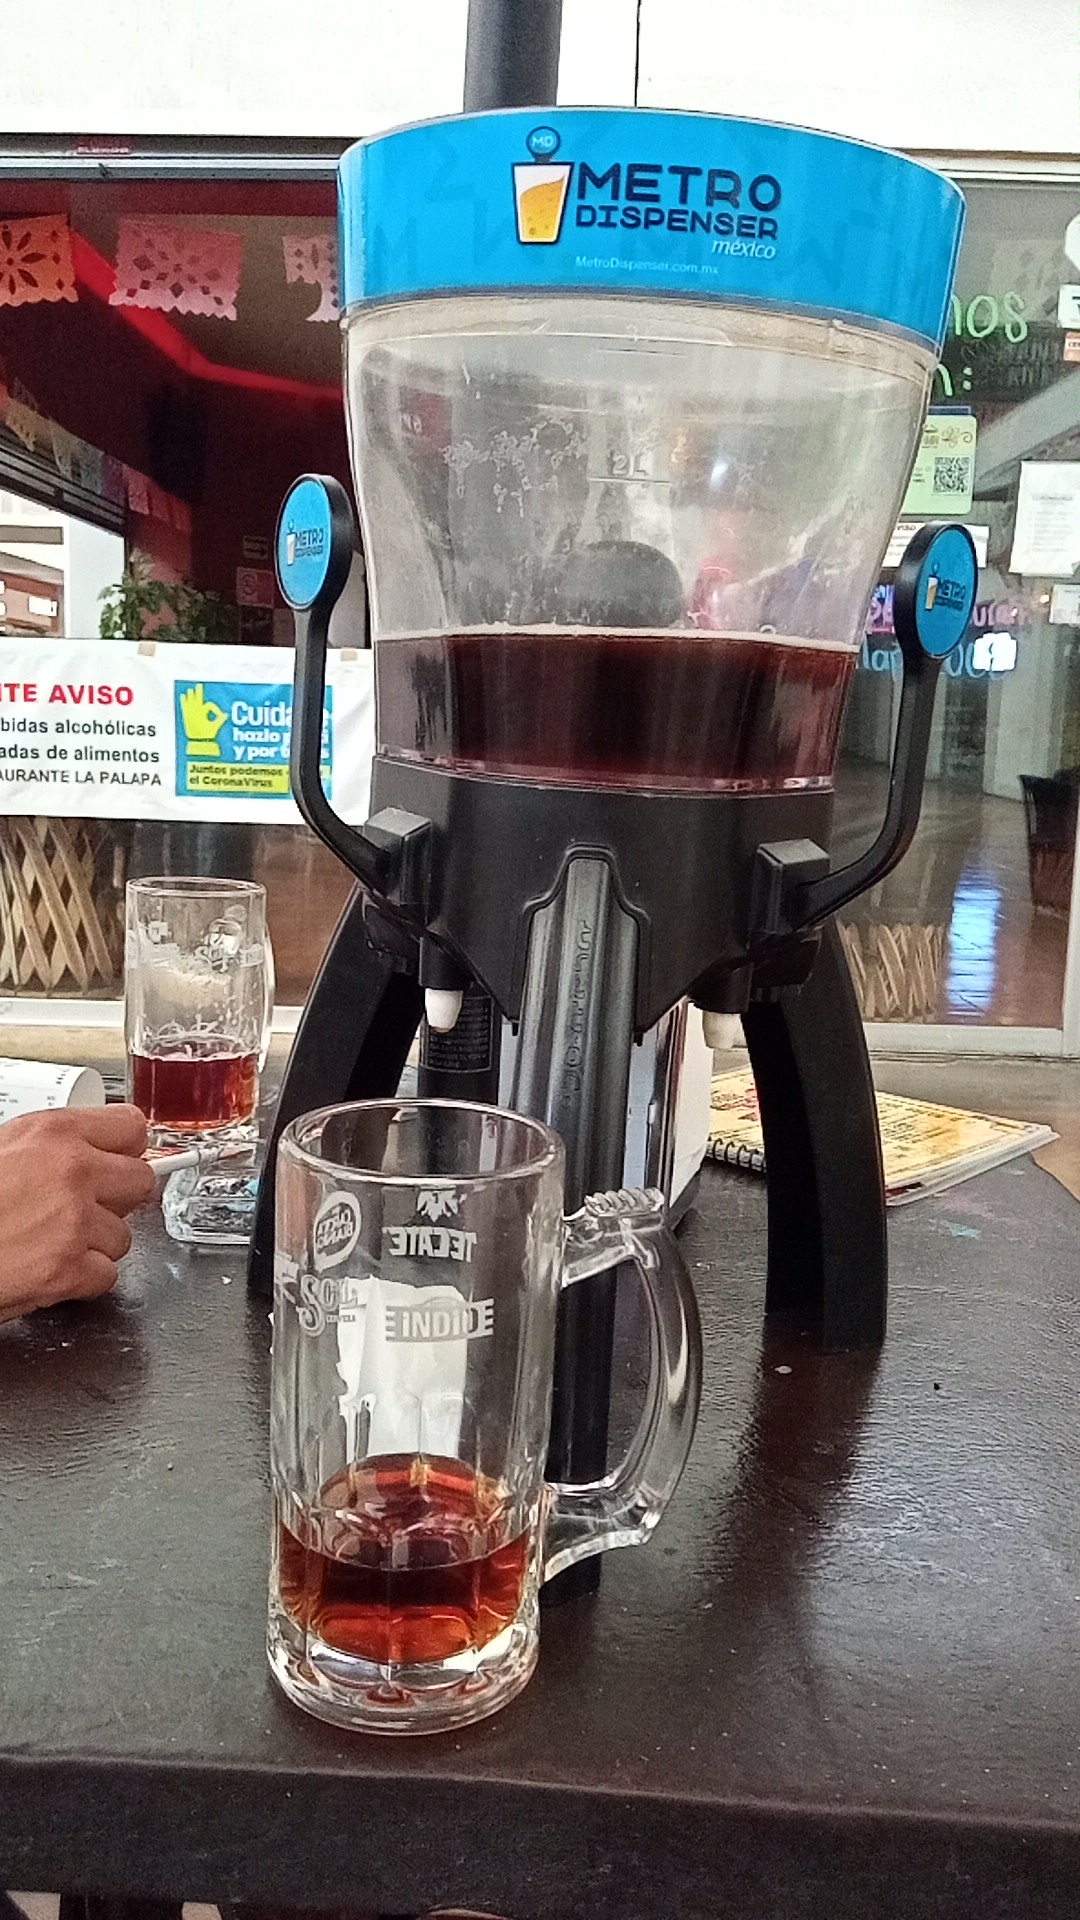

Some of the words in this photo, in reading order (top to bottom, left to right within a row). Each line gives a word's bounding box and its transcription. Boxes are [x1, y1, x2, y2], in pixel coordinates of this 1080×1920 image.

[577, 161, 782, 213] METRO
[575, 204, 778, 241] DISPENSER
[711, 239, 777, 260] méxico
[0, 683, 37, 703] TE
[48, 685, 134, 706] AVISO
[1, 717, 49, 734] bidas
[55, 719, 157, 738] alcohólicas
[47, 745, 68, 760] de
[74, 746, 160, 764] alimentos
[233, 746, 246, 761] y
[247, 746, 279, 761] por
[75, 771, 95, 784] LA
[100, 772, 162, 787] PALAPA
